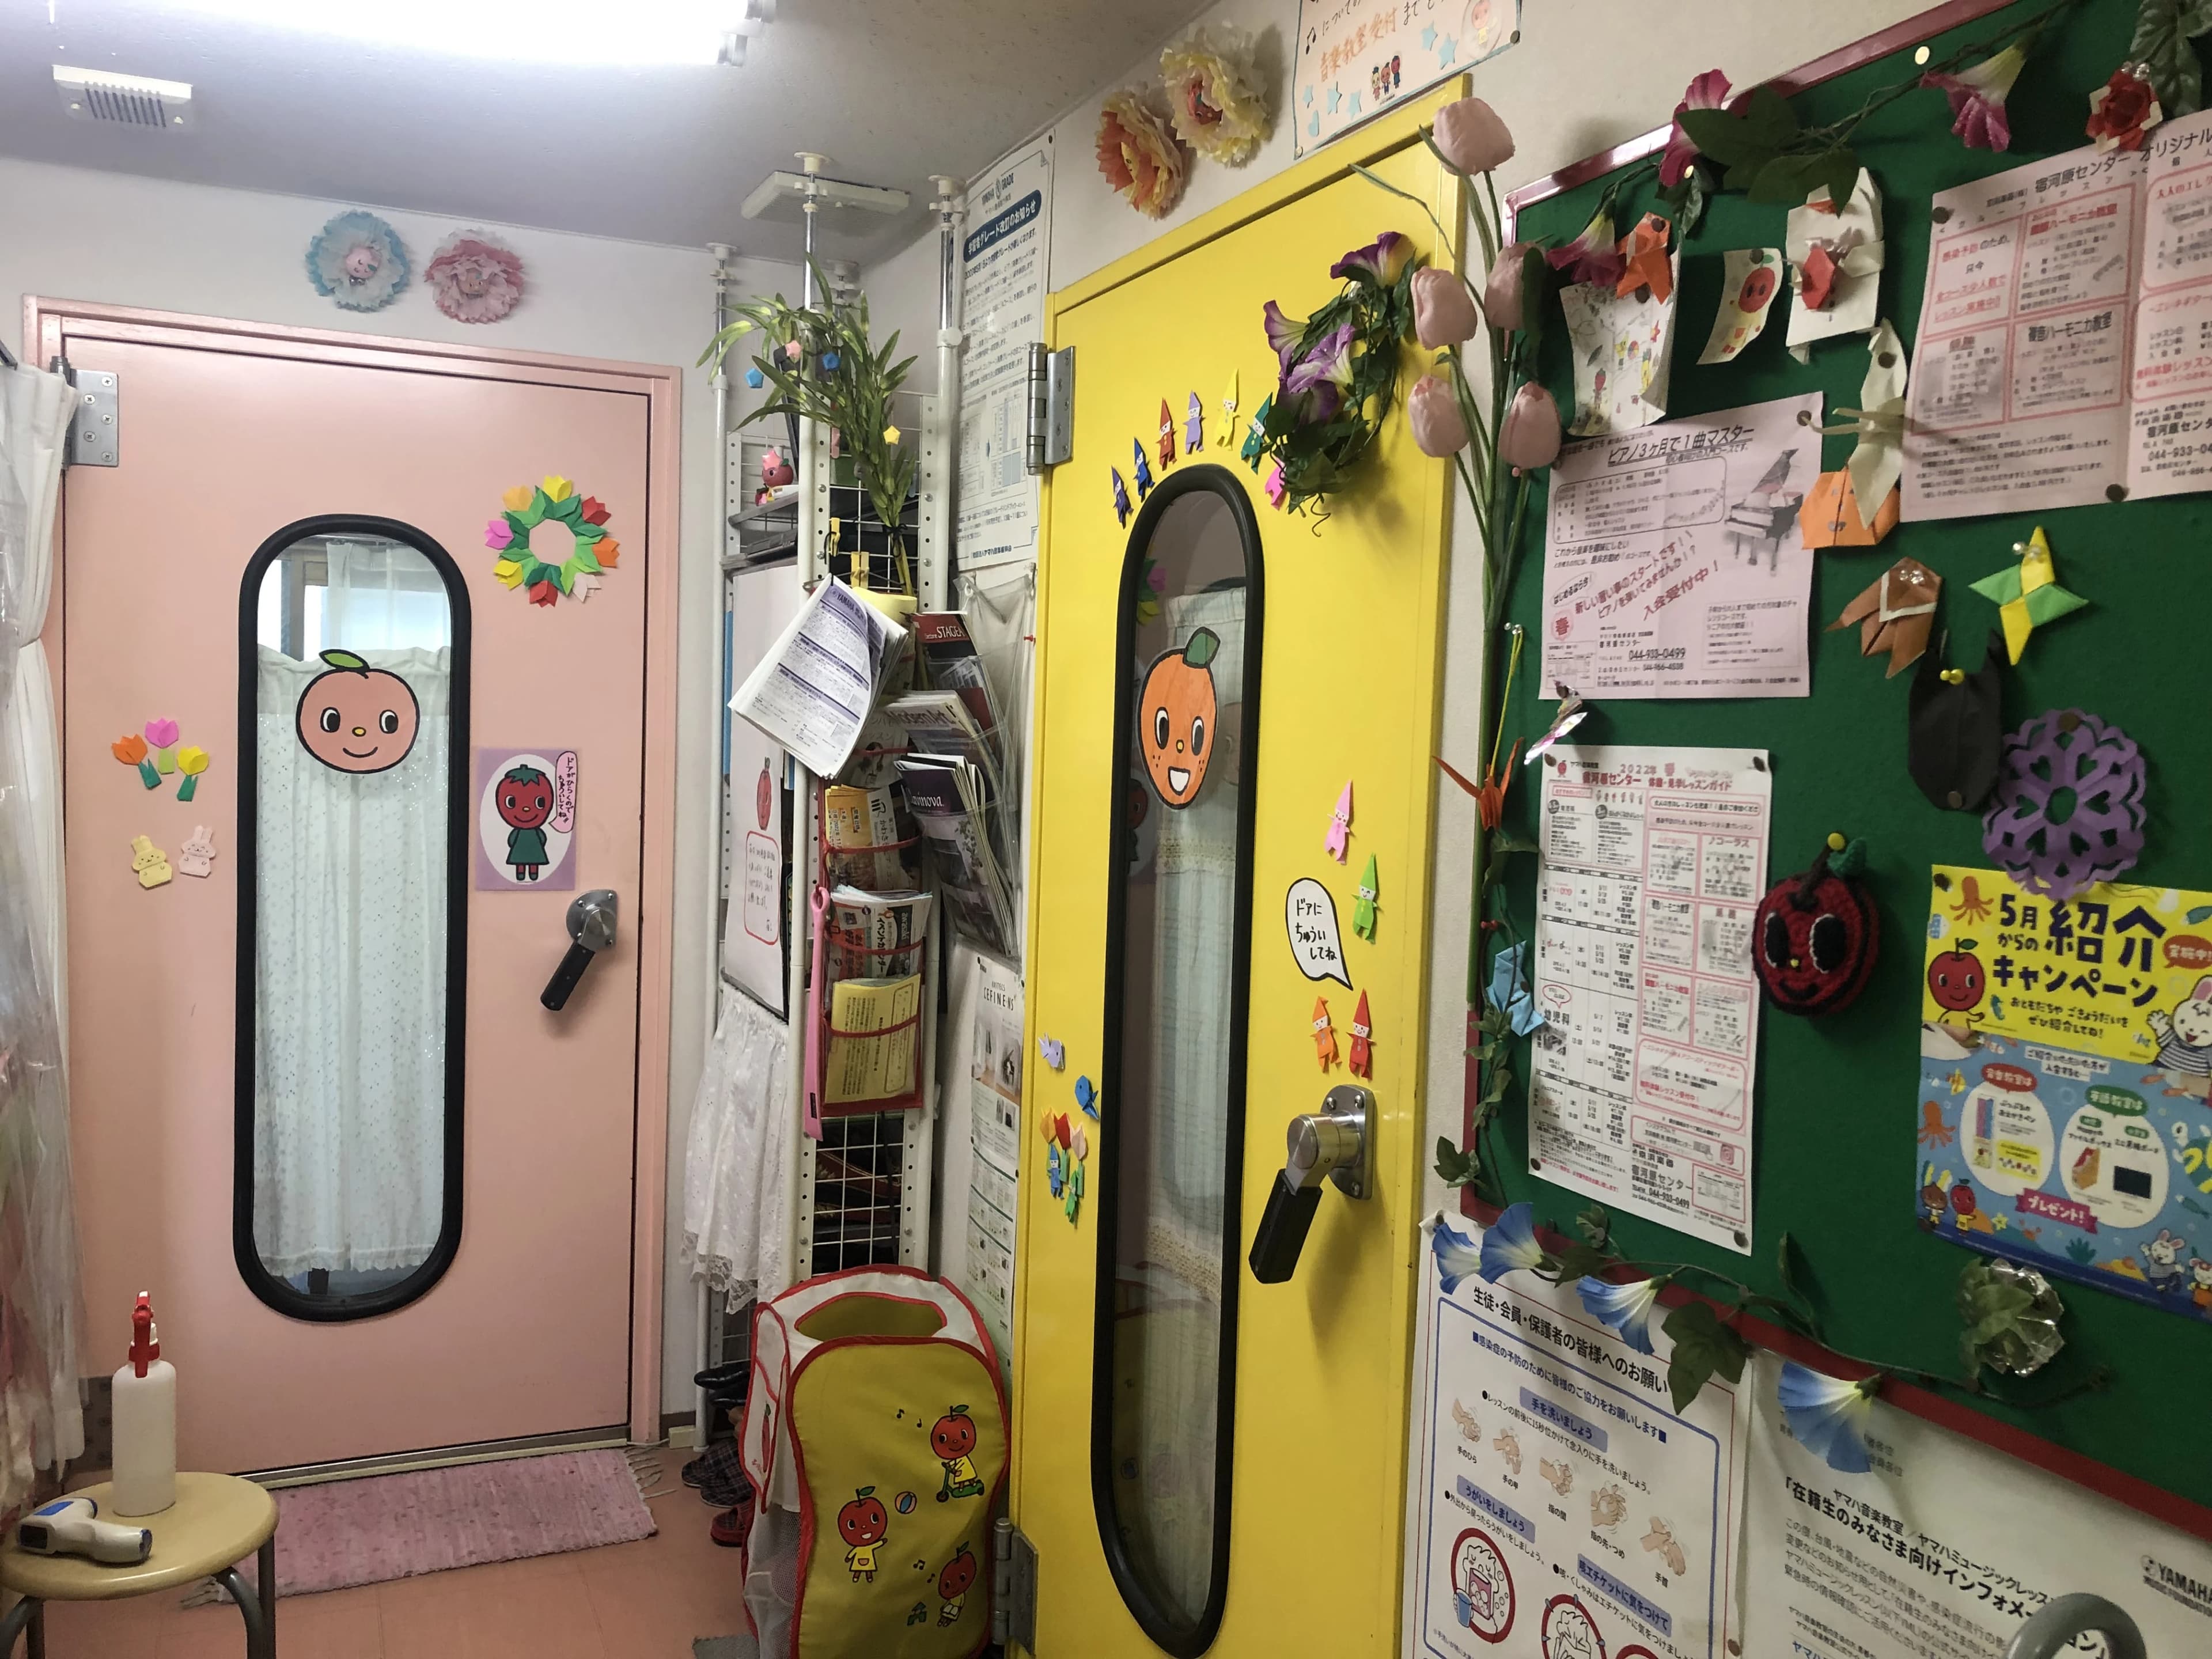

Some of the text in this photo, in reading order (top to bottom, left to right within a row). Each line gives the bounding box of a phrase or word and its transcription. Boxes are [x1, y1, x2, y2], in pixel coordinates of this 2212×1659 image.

[937, 626, 965, 639] STAGEA
[1555, 615, 1570, 637] 春
[1628, 647, 1686, 661] 044-933-0499
[1620, 763, 1657, 776] 2022年
[566, 757, 575, 813] ドアがひらくので
[1296, 897, 1323, 916] ドアに
[2000, 893, 2037, 930] 5月
[1295, 922, 1326, 943] ちゅうい
[1997, 932, 2039, 952] からの
[2044, 899, 2166, 972] 紹介
[1310, 946, 1337, 961] してね
[1993, 955, 2158, 1007] キャンペーン
[2011, 997, 2129, 1028] おともだちや ごきょうだいを
[2028, 1015, 2104, 1037] ぜひ紹介してね!
[2028, 1195, 2084, 1222] プレゼント!
[1473, 1285, 1668, 1393] 生徒・会員・保護者の皆様へのお願い
[1531, 1397, 1593, 1440] 手を洗いましょう
[1456, 1445, 1478, 1464] 手のひら
[1502, 1474, 1518, 1490] 手の甲
[1465, 1485, 1525, 1533] うがいをしましょう
[1548, 1503, 1567, 1522] 指の間
[1590, 1529, 1626, 1559] 指の先・つめ
[1655, 1571, 1669, 1588] 手首
[1579, 1559, 1669, 1631] 咳エチケットに気をつけて
